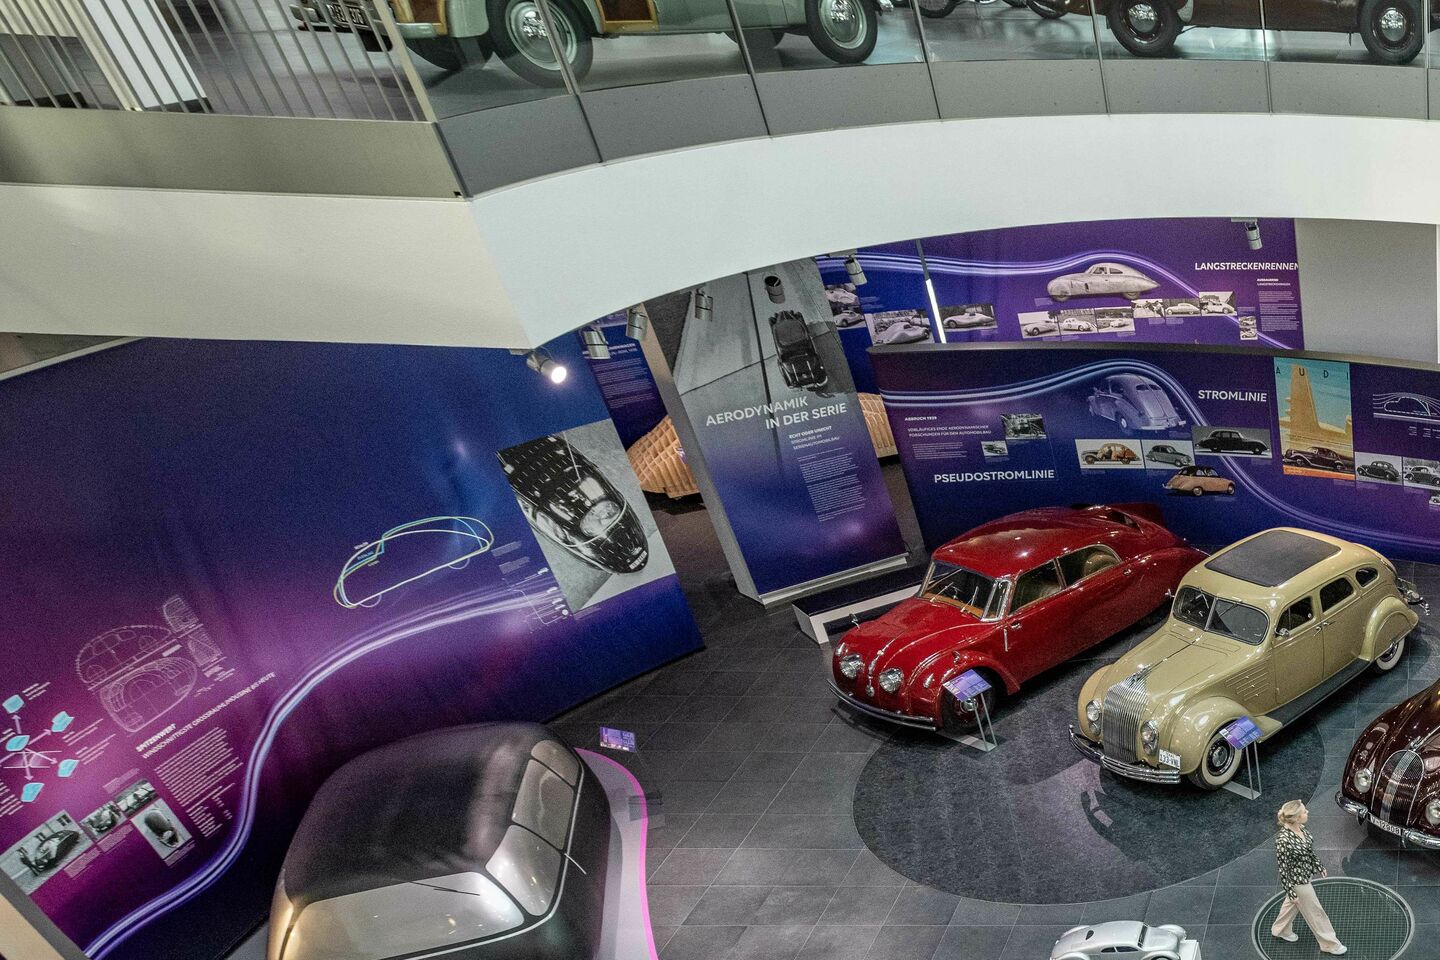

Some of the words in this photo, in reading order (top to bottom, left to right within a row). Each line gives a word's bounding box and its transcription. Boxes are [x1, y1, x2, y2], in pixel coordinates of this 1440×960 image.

[1195, 262, 1299, 271] LANGSTRECKENRENNEN
[1198, 389, 1268, 402] STROMLINIE
[705, 396, 809, 427] AERODYNAMIK
[765, 418, 780, 430] IN
[783, 411, 810, 426] DER
[811, 402, 847, 420] SERIE
[934, 469, 1055, 483] PSEUDOSTROMLINIE
